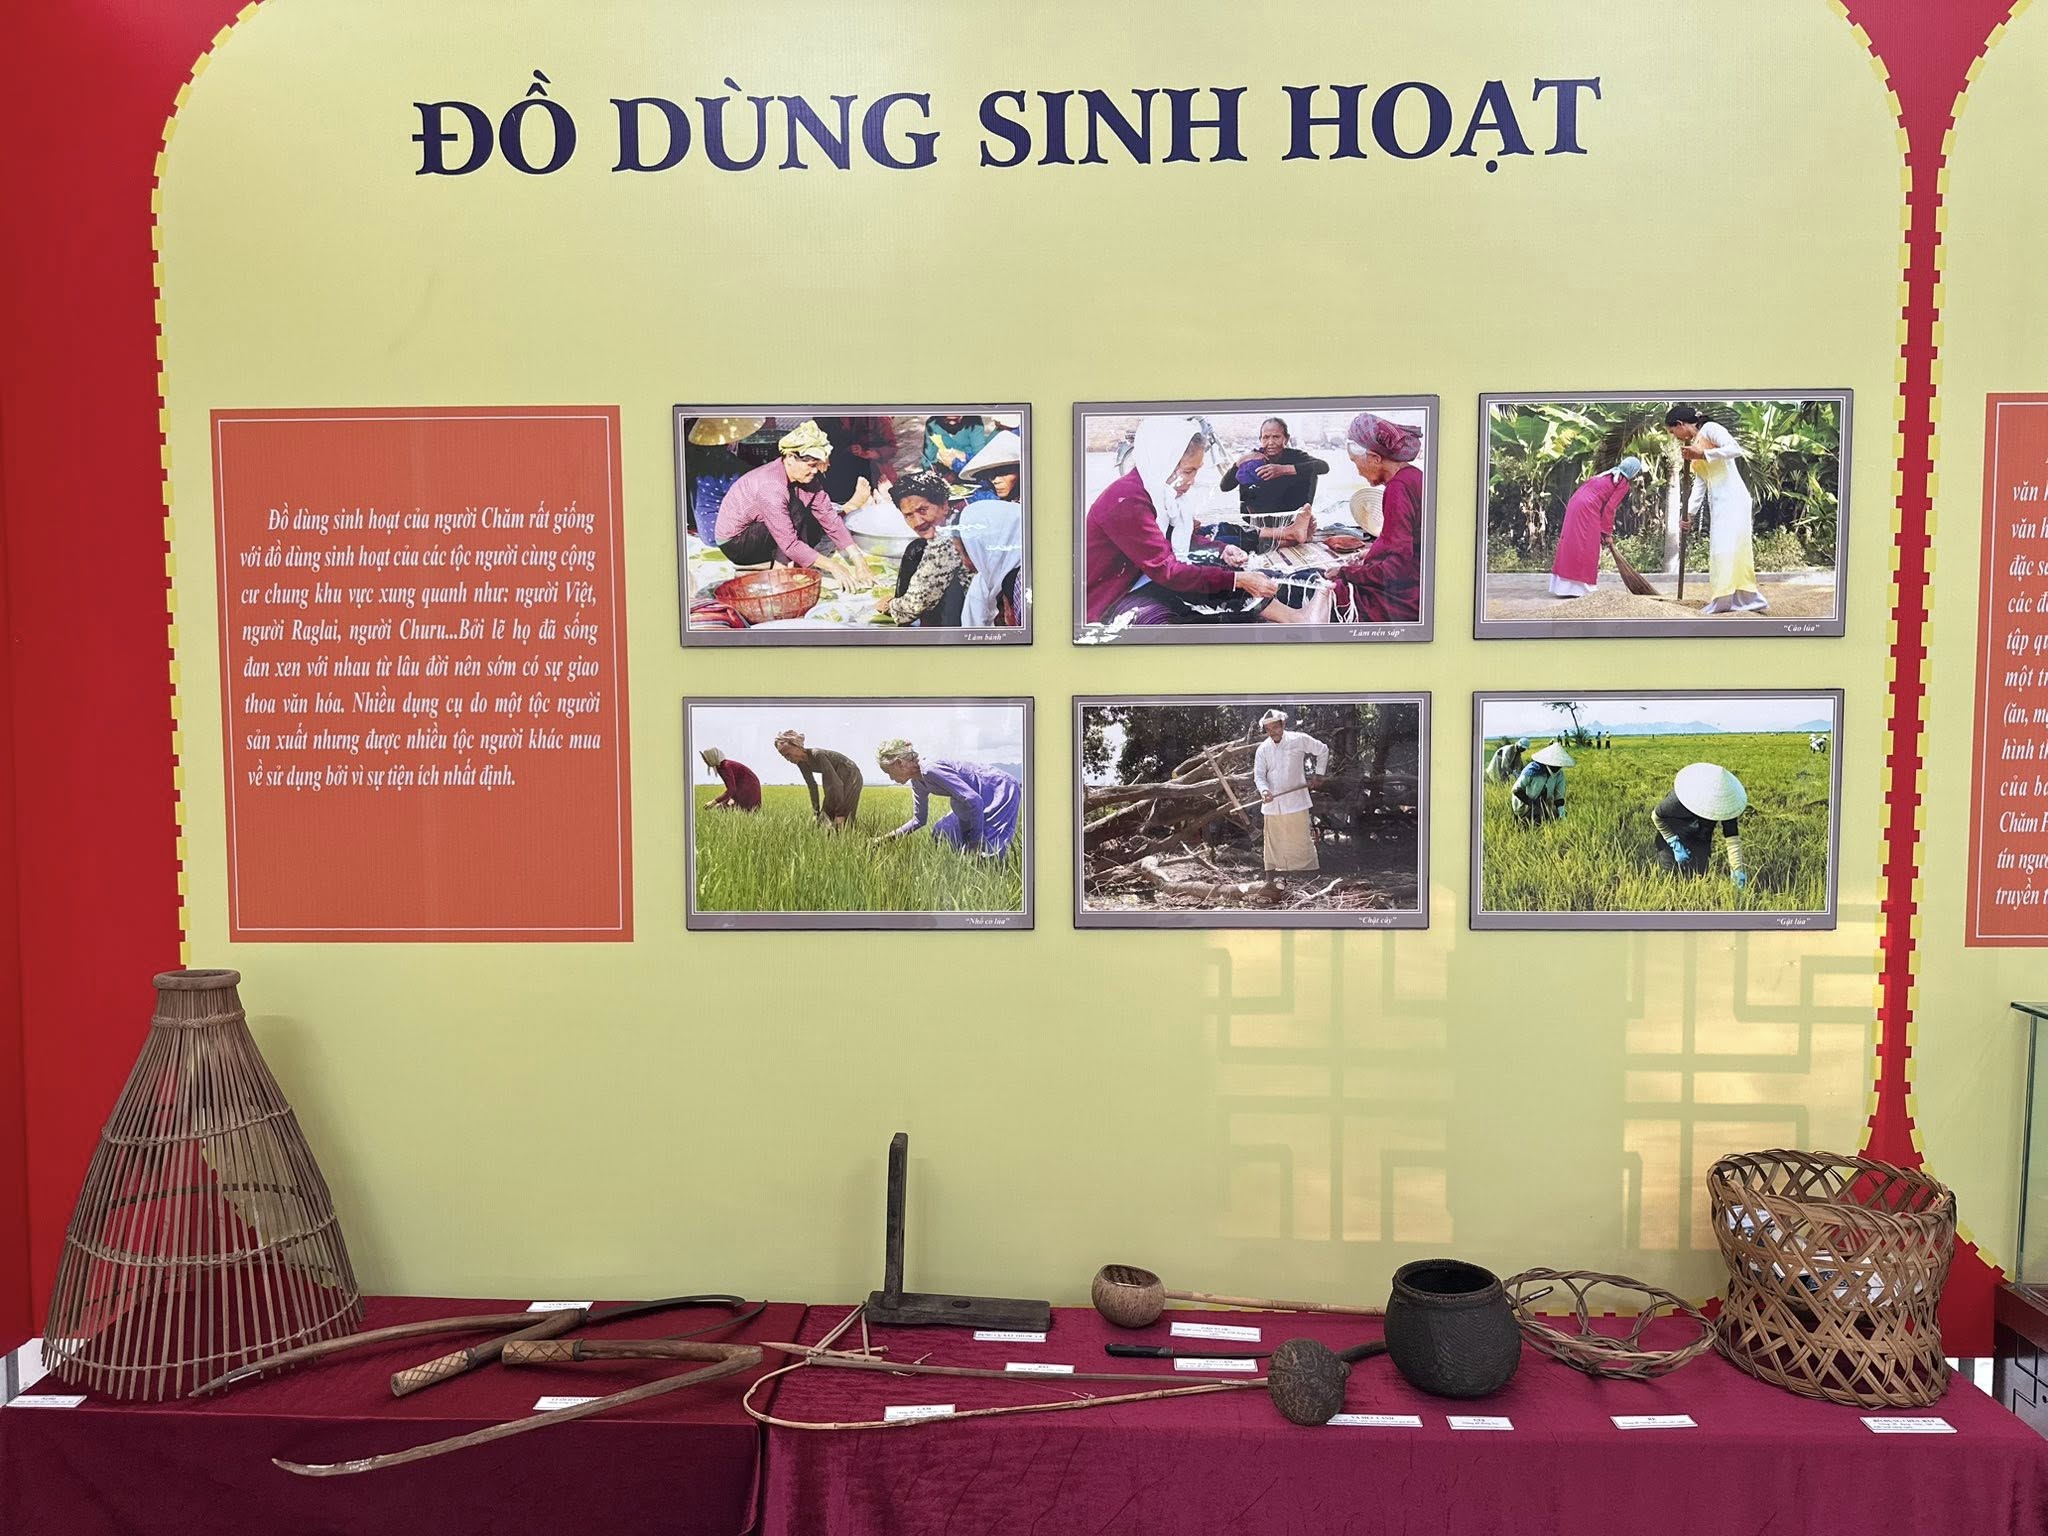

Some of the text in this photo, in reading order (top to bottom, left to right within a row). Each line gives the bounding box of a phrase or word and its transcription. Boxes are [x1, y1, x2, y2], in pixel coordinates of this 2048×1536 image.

[411, 69, 1602, 176] ĐỒ DÙNG SINH HOẠT
[2013, 480, 2039, 501] văn
[267, 500, 596, 536] Đồ dùng sinh hoạt của người Chăm rất giống
[2011, 518, 2036, 539] văn
[239, 539, 597, 573] với đồ dùng sinh hoạt của các tộc người cùng cộng
[2009, 555, 2035, 582] đặc
[240, 580, 597, 610] cư chung khu vực xung quanh như: người Việt,
[2008, 591, 2033, 613] các
[242, 618, 285, 647] người
[291, 618, 342, 646] Raglai,
[349, 617, 393, 646] người
[491, 617, 506, 640] lẽ
[512, 617, 531, 646] họ
[538, 617, 557, 640] đã
[563, 611, 599, 646] sống
[2006, 628, 2029, 656] tập
[243, 654, 599, 683] đan xen với nhau từ lâu đời nên sớm có sự giao
[2004, 665, 2034, 692] một
[244, 685, 601, 719] thoa văn hóa. Nhiều dụng cụ do một tộc người
[2004, 702, 2028, 727] (ăn,
[246, 721, 601, 756] sản xuất nhưng được nhiều tộc người khác mua
[2001, 738, 2034, 760] hình
[247, 758, 516, 792] về sử dụng bởi vì sự tiện ích nhất định.
[2000, 774, 2028, 797] của
[1999, 811, 2039, 833] Chăm
[1997, 847, 2015, 869] tín
[1995, 877, 2040, 911] truyền
